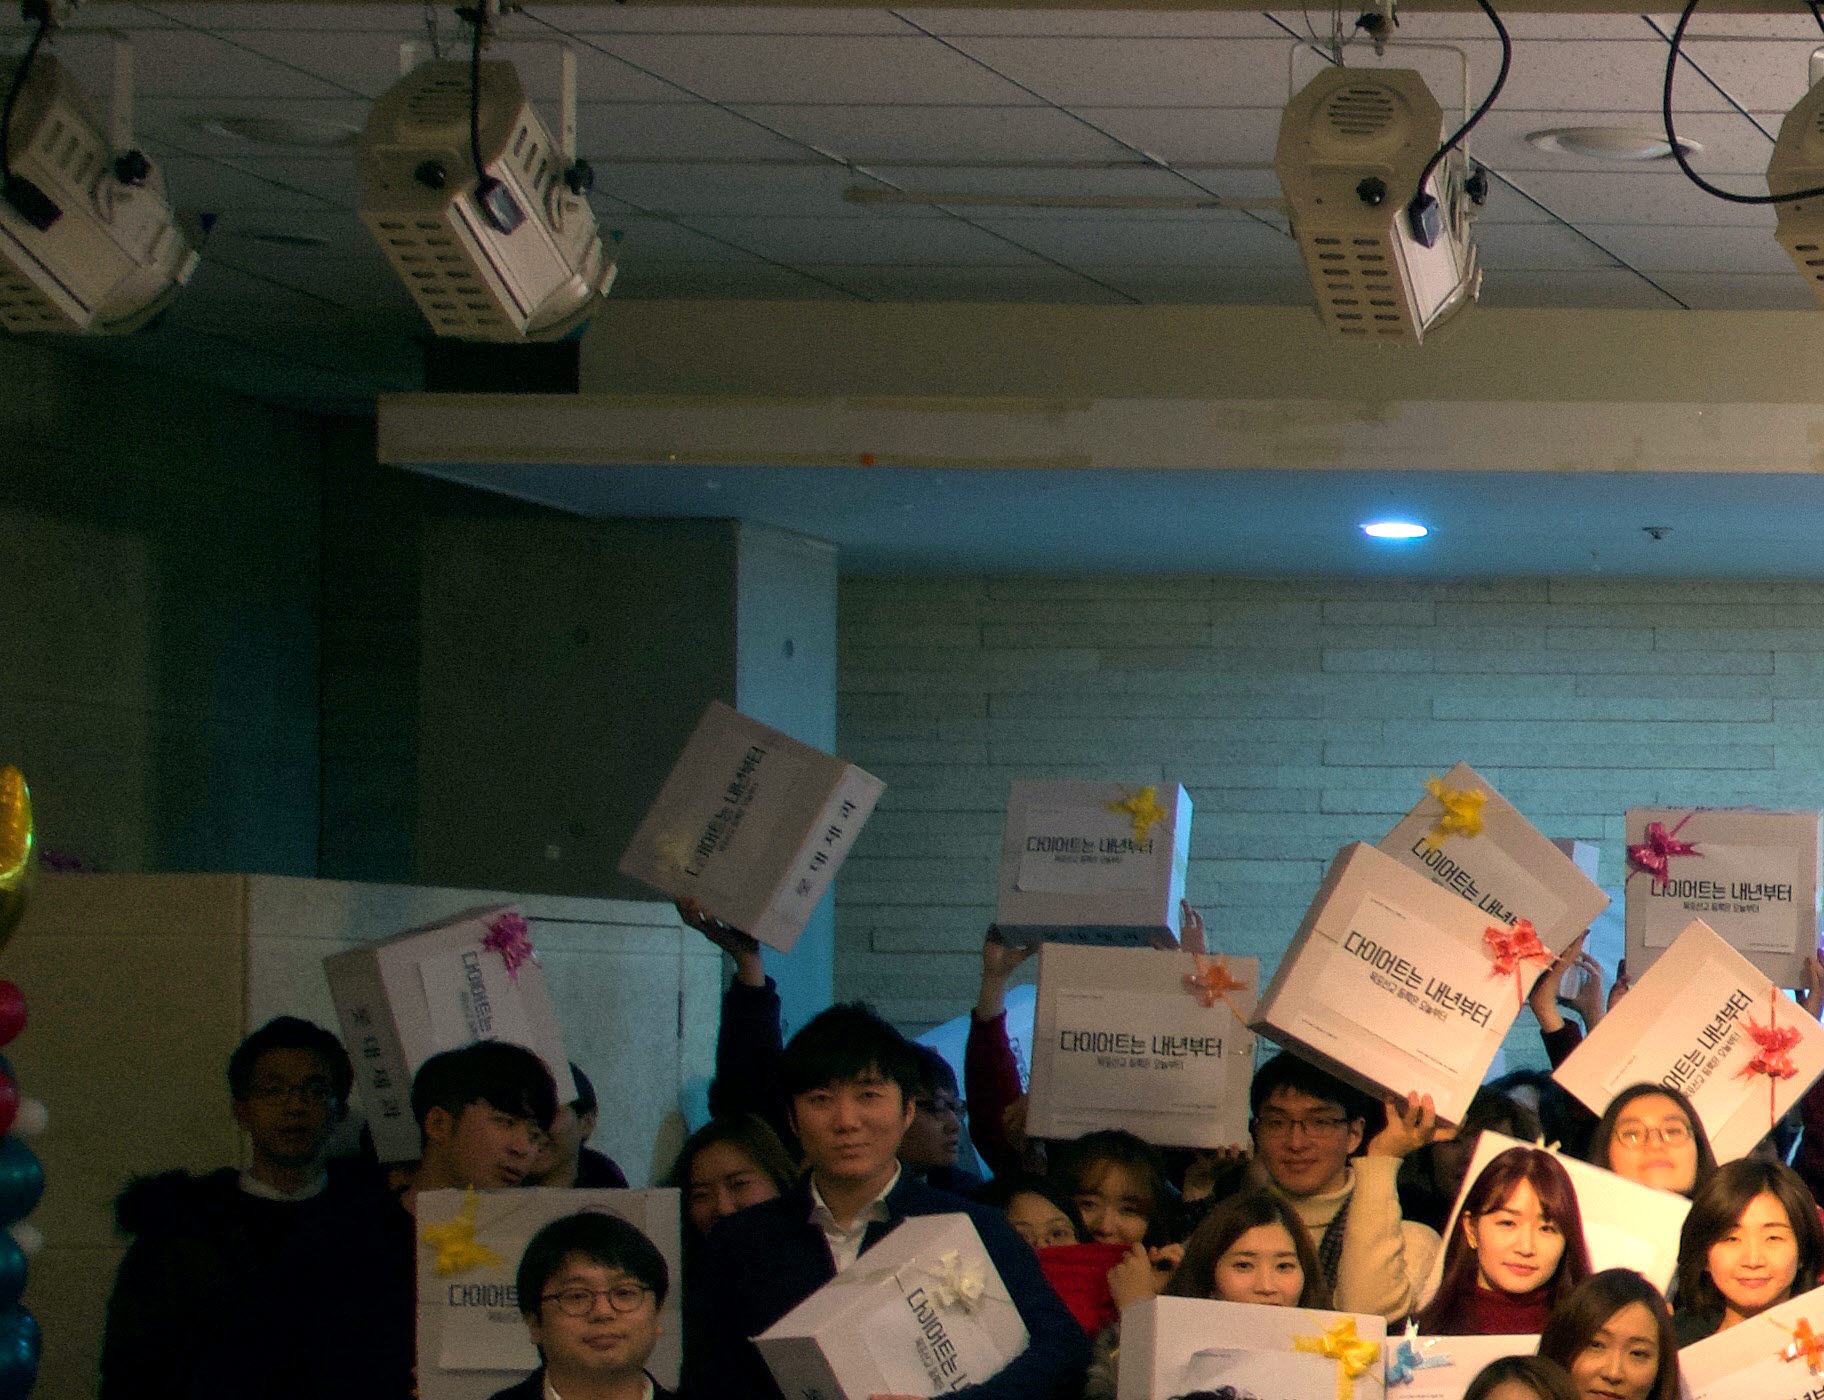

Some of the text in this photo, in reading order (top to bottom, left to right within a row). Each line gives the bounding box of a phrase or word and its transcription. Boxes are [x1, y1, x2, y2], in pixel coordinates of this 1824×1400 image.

[1027, 836, 1094, 853] 다이어트는
[1411, 837, 1480, 902] 다이어트는
[1650, 879, 1792, 902] 다이어트는 내년부터
[1344, 930, 1493, 1028] 다이어트는 내년부터
[1061, 1030, 1222, 1058] 다이어트는 내년부터
[1697, 989, 1753, 1050] 내년부터
[906, 1287, 960, 1380] 다이어트는
